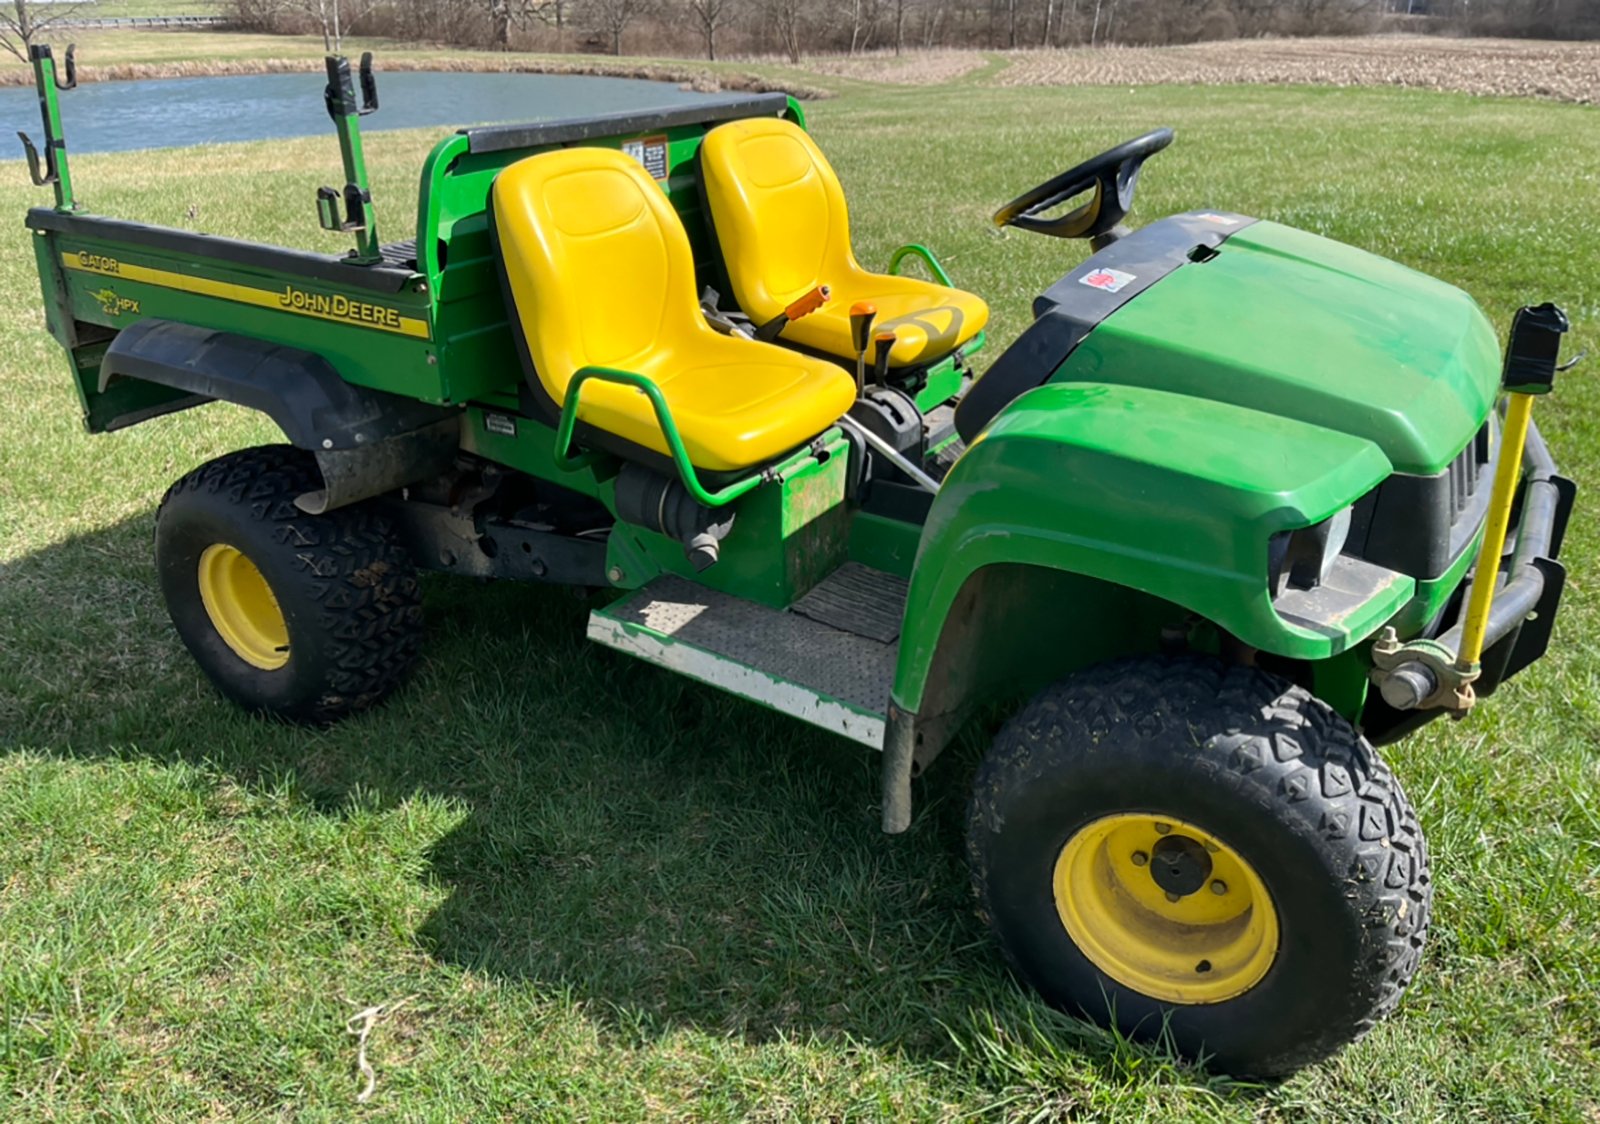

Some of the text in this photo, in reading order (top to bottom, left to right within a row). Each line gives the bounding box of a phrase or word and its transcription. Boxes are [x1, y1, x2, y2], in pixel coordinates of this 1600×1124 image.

[78, 251, 119, 273] GATOR
[116, 298, 140, 314] HPX
[280, 285, 400, 327] JOHN DEERE
